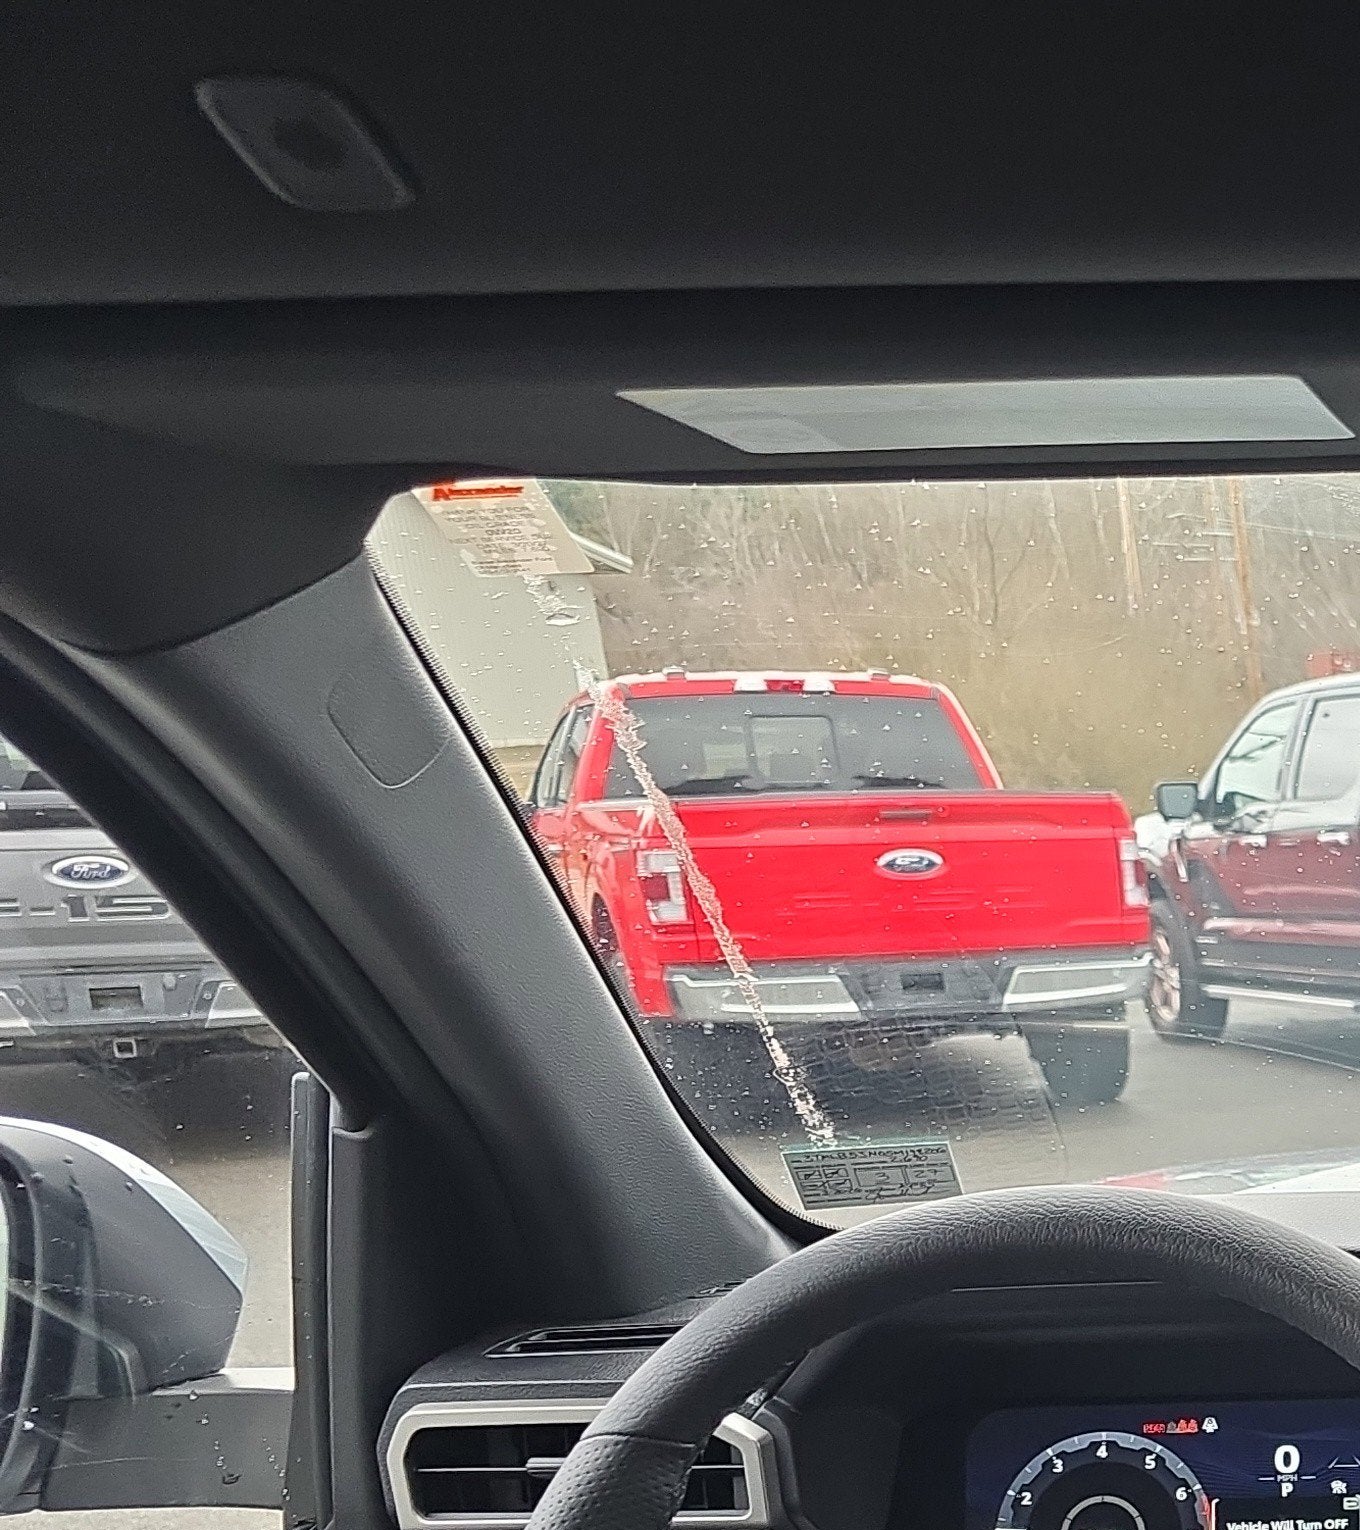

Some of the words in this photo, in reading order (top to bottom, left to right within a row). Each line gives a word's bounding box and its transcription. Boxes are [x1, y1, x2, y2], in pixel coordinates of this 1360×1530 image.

[1096, 1446, 1108, 1459] 4
[1274, 1445, 1300, 1474] 0
[1052, 1458, 1064, 1473] 3
[1144, 1455, 1156, 1469] 5
[1276, 1474, 1299, 1482] MPH
[1175, 1487, 1187, 1501] 6
[1281, 1483, 1294, 1497] P
[1020, 1492, 1033, 1506] 2
[1296, 1520, 1323, 1530] Turn
[1324, 1519, 1349, 1530] OFF
